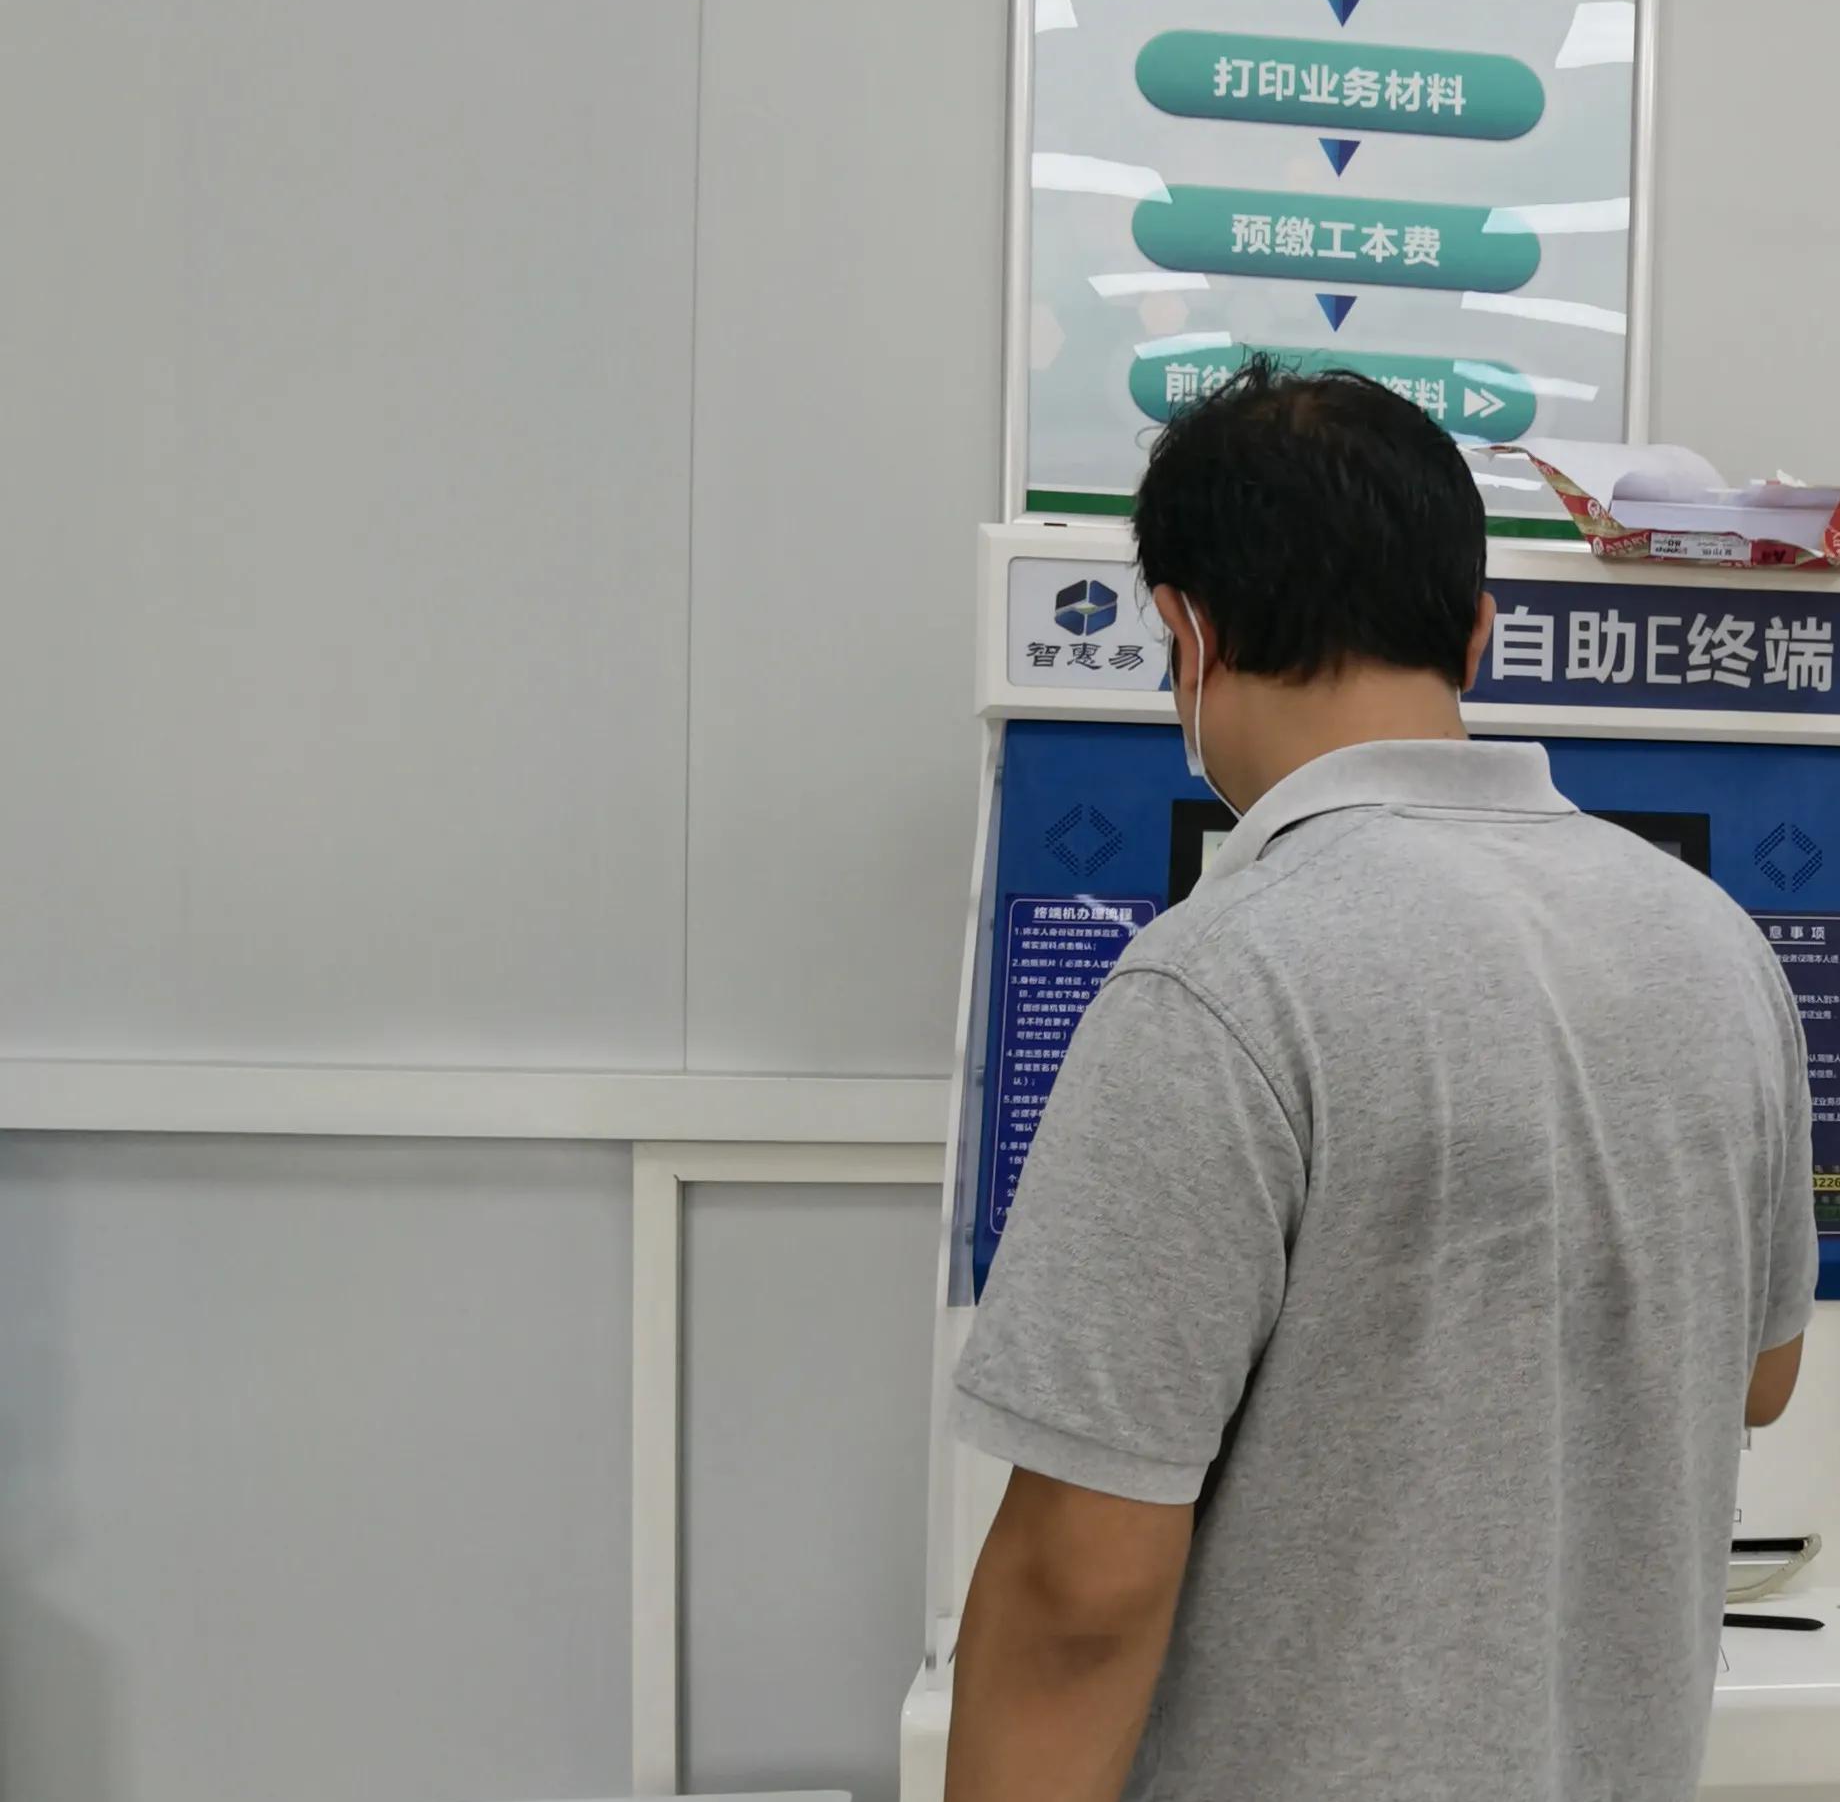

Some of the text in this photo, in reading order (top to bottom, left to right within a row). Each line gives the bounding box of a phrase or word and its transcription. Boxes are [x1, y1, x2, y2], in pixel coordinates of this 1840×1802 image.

[1213, 58, 1467, 116] 打印业务材料
[1231, 213, 1441, 267] 预缴工本费
[1492, 605, 1834, 692] 自助E终端
